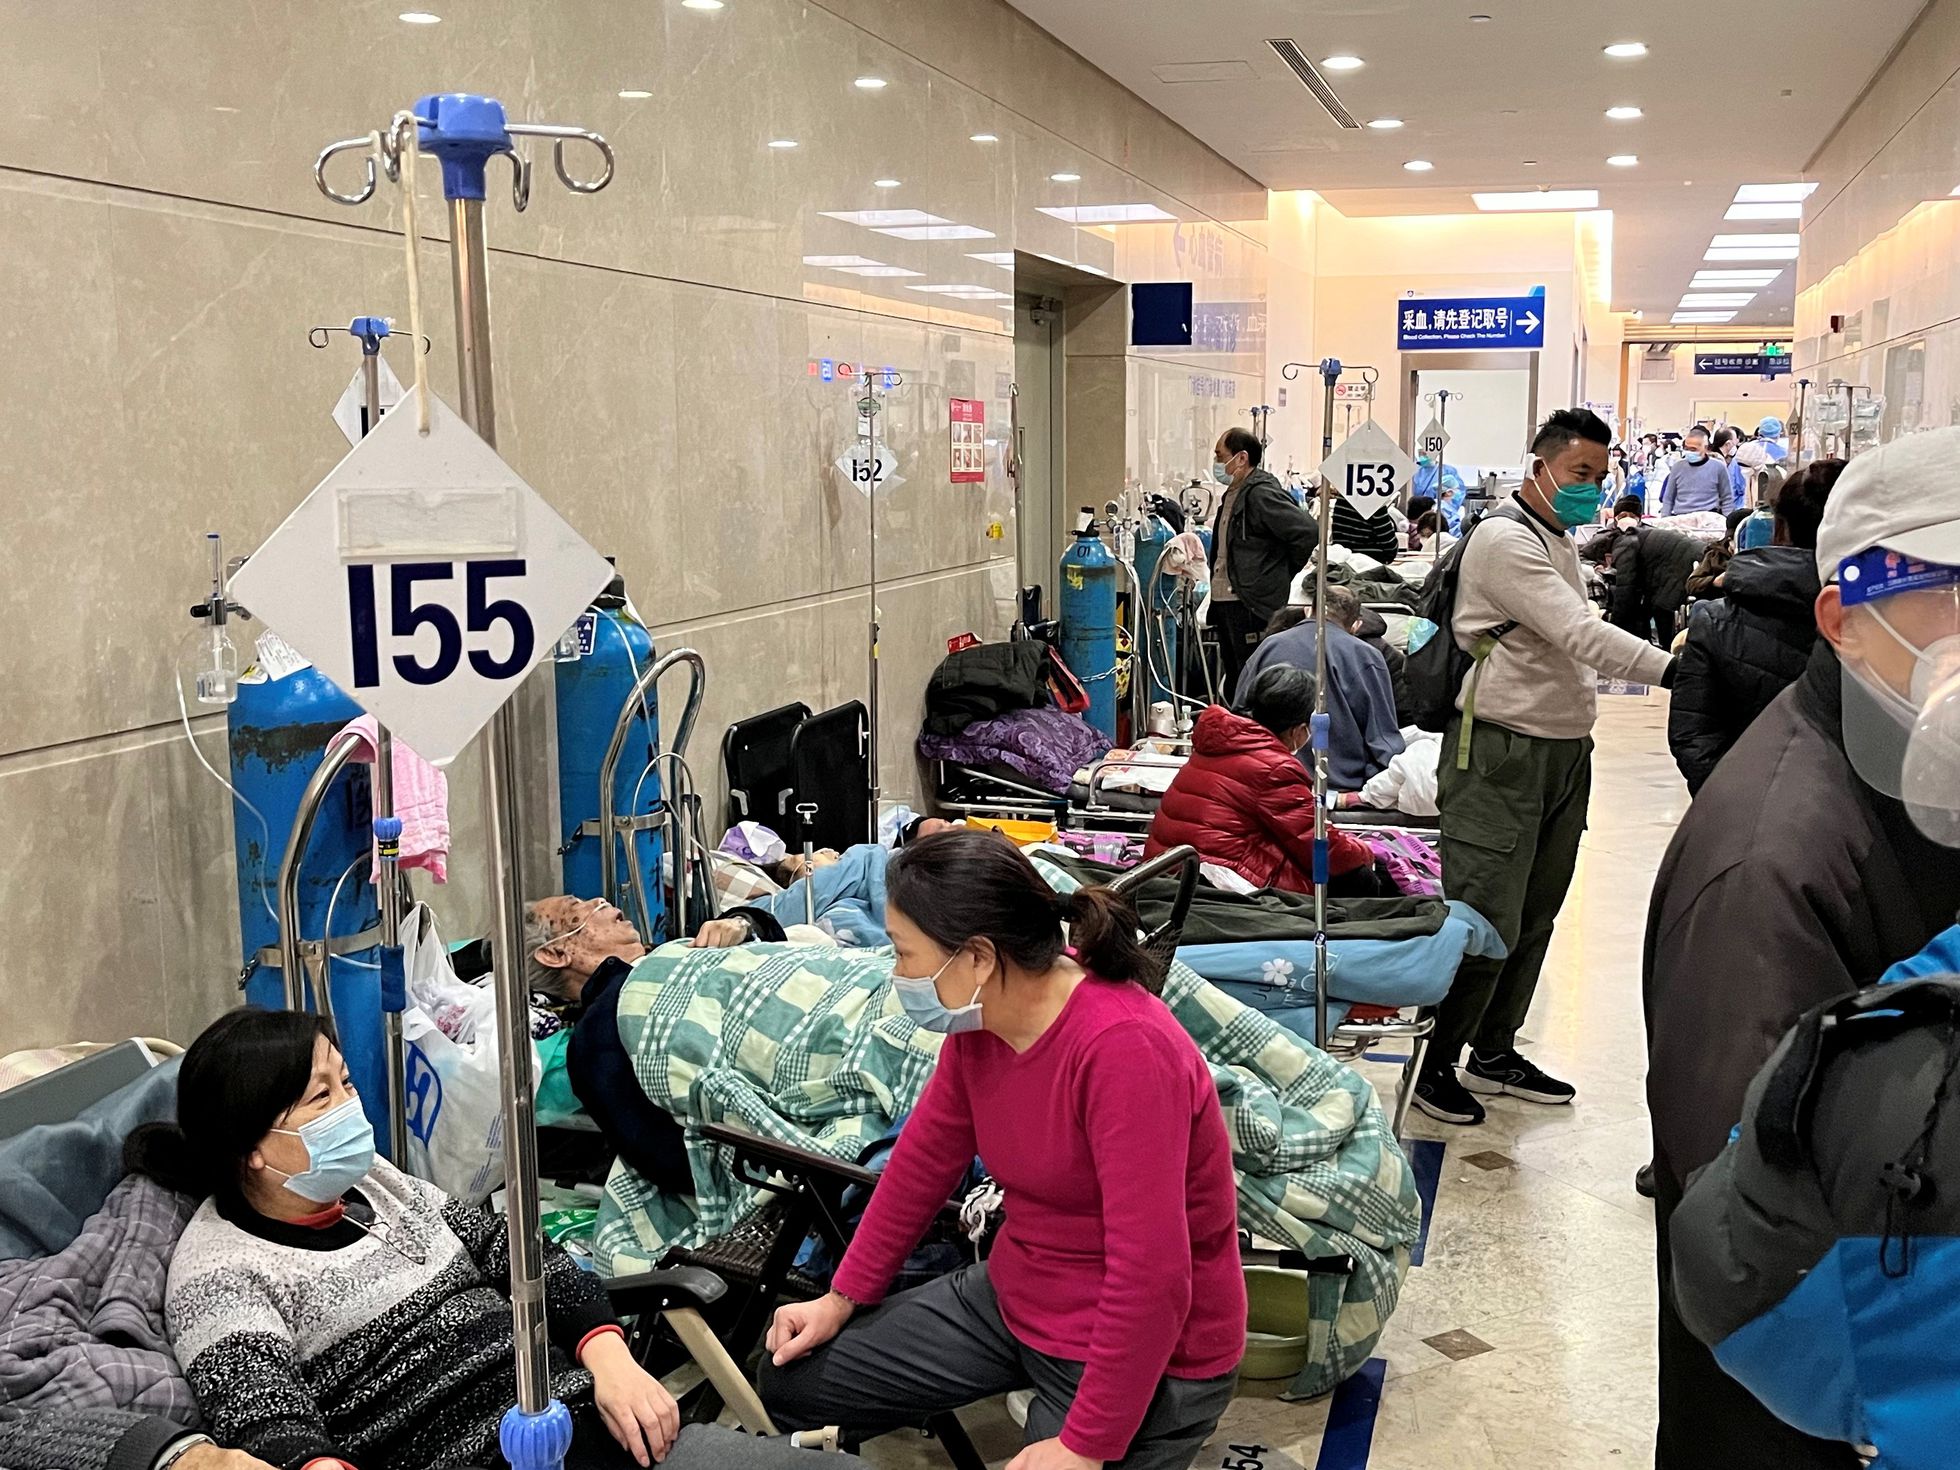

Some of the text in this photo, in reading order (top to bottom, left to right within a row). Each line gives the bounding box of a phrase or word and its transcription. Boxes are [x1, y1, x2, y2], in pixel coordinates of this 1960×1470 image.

[1425, 436, 1443, 452] 150
[852, 458, 883, 482] 152
[1345, 463, 1395, 497] 153
[347, 559, 535, 688] 155
